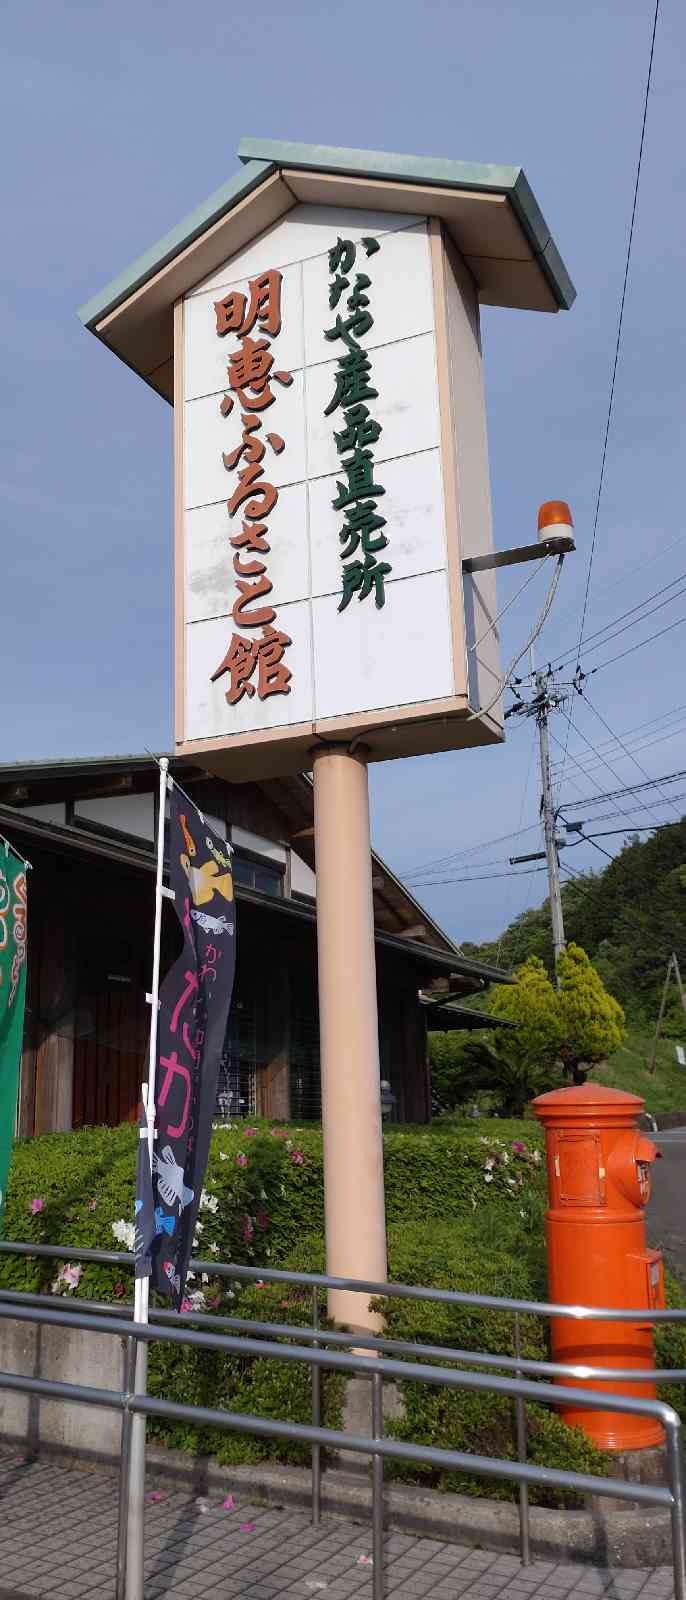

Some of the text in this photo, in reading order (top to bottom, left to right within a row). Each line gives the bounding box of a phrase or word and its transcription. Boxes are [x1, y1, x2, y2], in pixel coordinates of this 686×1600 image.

[210, 269, 293, 706] 明恵ふるさと館
[323, 236, 392, 612] かなや産品直売所
